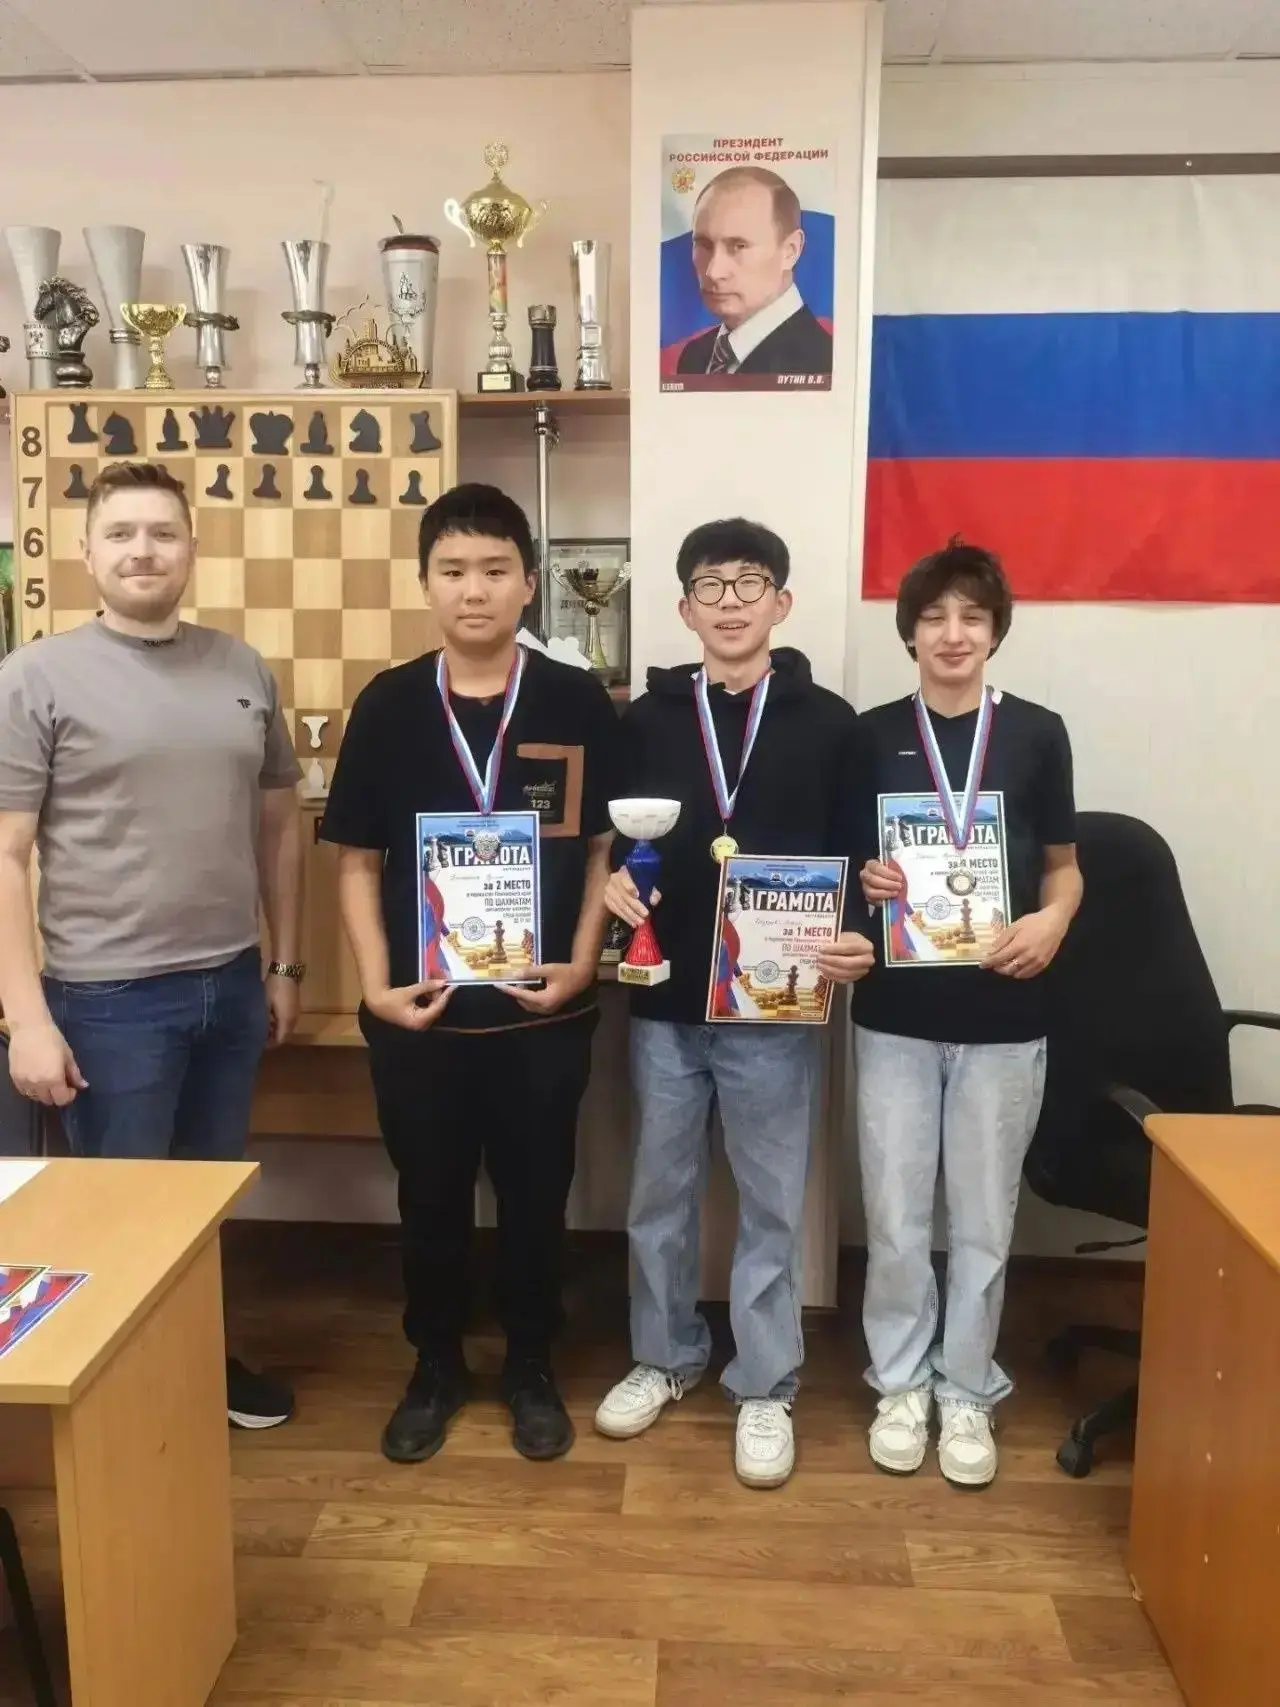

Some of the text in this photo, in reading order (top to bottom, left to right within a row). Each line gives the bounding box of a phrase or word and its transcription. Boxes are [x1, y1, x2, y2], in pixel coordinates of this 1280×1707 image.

[713, 137, 784, 149] ПРЕЗИДЕНТ
[669, 149, 829, 163] РОССИЙСКОЙ ФЕДЕРАЦИИ
[777, 375, 806, 384] ПУТИН
[21, 426, 43, 457] 8
[22, 476, 43, 508] 7
[23, 527, 44, 558] 6
[24, 577, 46, 609] 5
[531, 799, 551, 809] 123
[916, 825, 996, 844] ГРАТА
[969, 858, 998, 868] МЕСТО
[496, 880, 501, 890] 2
[504, 880, 531, 889] МЕСТО
[484, 898, 532, 906] ПО ШАХМАТАМ
[756, 890, 834, 912] ГРАМОТА
[797, 927, 801, 936] 1
[804, 927, 832, 937] МЕСТО
